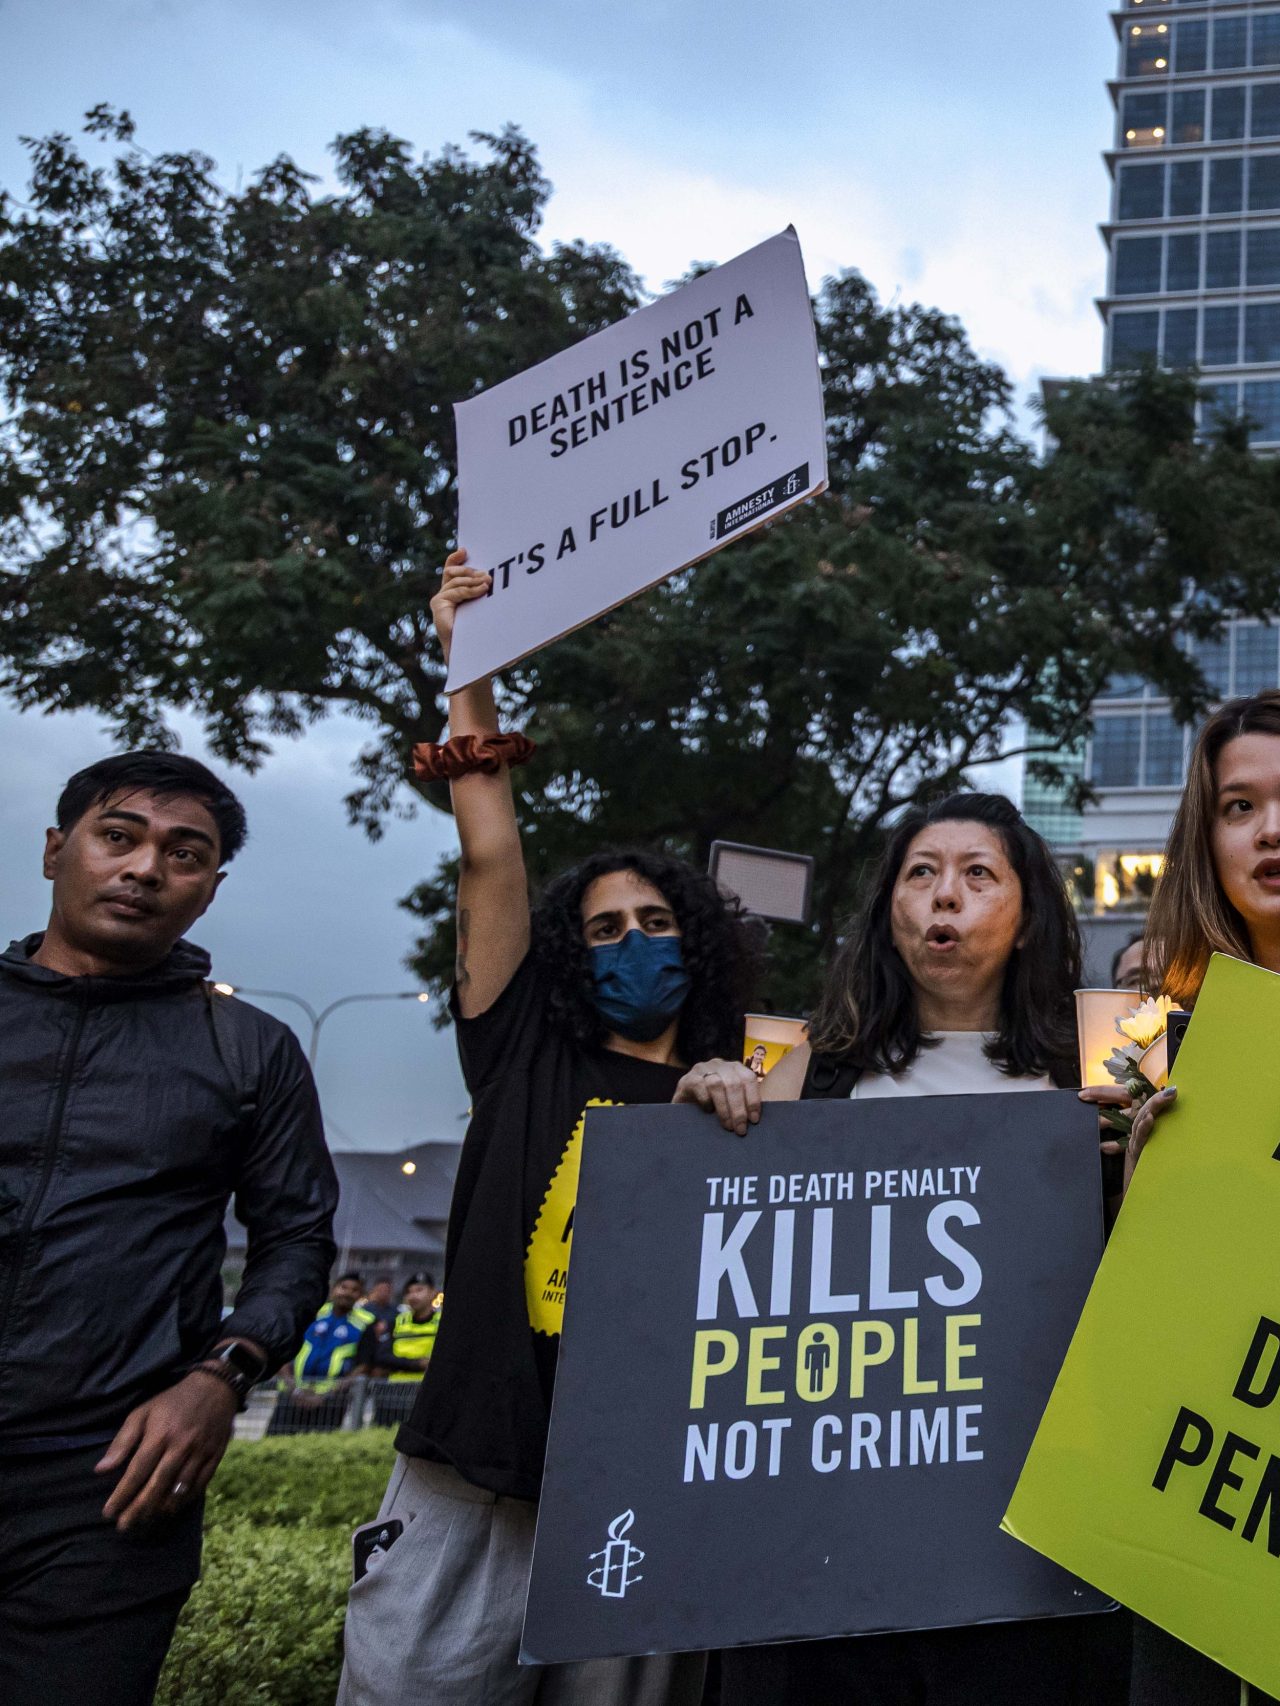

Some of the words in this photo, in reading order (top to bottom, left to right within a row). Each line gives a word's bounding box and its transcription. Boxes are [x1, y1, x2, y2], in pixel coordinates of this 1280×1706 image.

[508, 371, 607, 447] DEATH
[620, 349, 650, 387] IS
[661, 307, 722, 364] NOT
[734, 293, 755, 326] A
[550, 347, 716, 458] SENTENCE
[487, 542, 546, 598] IT'S
[556, 526, 577, 561] A
[589, 478, 669, 542] FULL
[680, 421, 778, 491] STOP.
[724, 498, 775, 530] INTERNATIONAL
[725, 487, 776, 523] AMNESTY
[706, 1176, 758, 1206] THE
[769, 1172, 854, 1203] DEATH
[865, 1166, 981, 1199] PENALTY
[696, 1200, 982, 1320] KILLS
[690, 1314, 983, 1410] PEOPLE
[684, 1418, 792, 1482] NOT
[811, 1404, 984, 1474] CRIME
